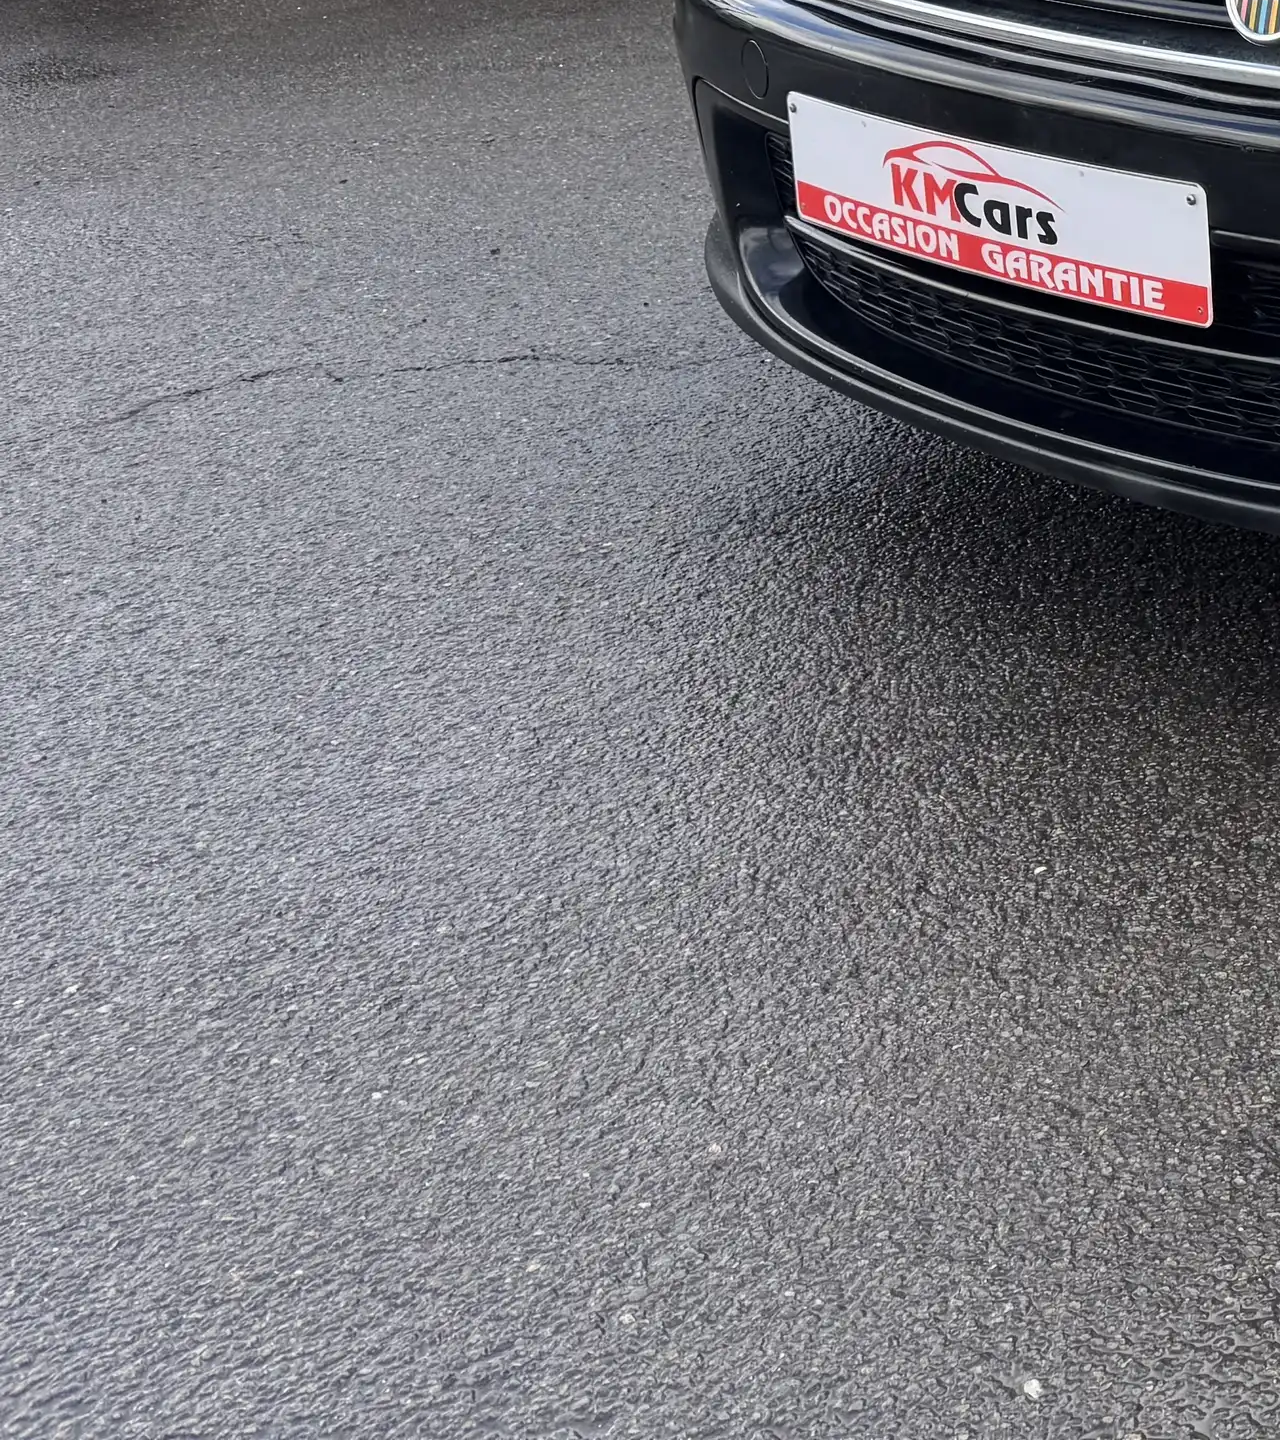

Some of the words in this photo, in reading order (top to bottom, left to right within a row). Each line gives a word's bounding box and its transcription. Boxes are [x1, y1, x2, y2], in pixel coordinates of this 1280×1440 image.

[822, 194, 960, 262] OCCASION
[980, 242, 1167, 312] GARANTIE
[888, 161, 1060, 247] KMCars
